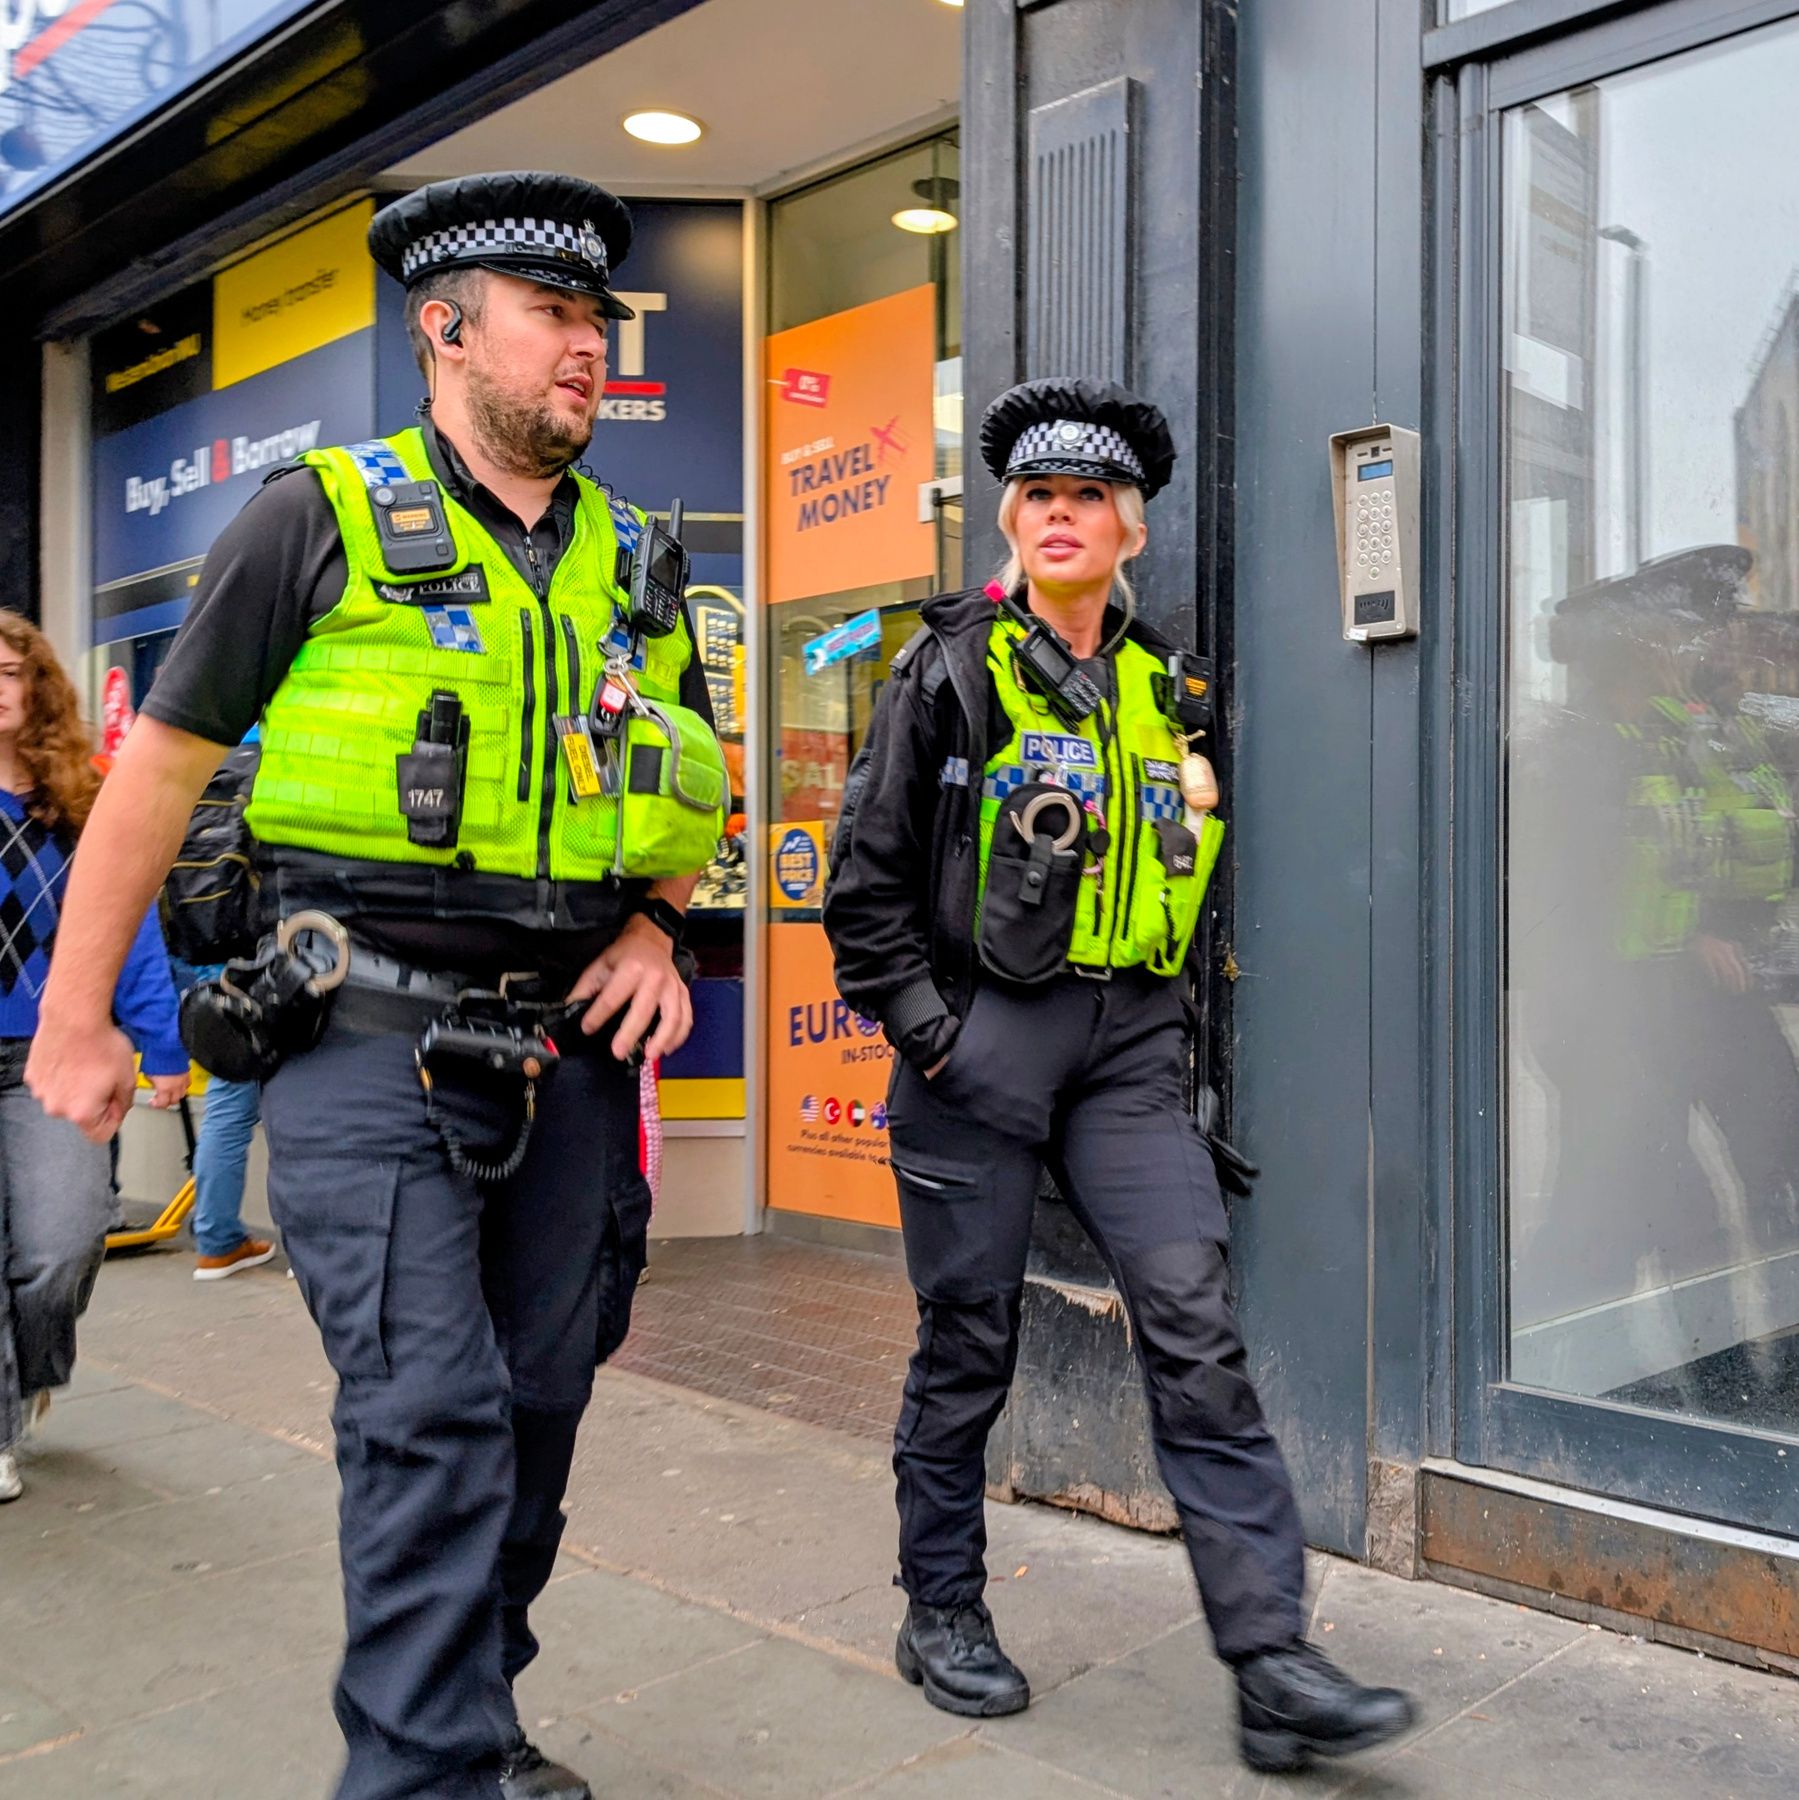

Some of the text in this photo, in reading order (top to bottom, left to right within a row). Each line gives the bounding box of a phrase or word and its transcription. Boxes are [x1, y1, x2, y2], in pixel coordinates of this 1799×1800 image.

[611, 291, 667, 376] T
[597, 398, 667, 422] KERS
[126, 420, 322, 516] Buy, Sell & Borrow
[789, 443, 875, 497] TRAVEL
[797, 474, 892, 532] MONEY
[419, 578, 481, 594] POLICE
[1027, 737, 1094, 761] POLICE
[566, 735, 588, 794] FUEL ONLY
[578, 744, 594, 783] DIESEL
[781, 759, 845, 790] SAL
[408, 788, 444, 808] 1747
[780, 852, 814, 869] BEST
[780, 868, 815, 883] PRICE
[841, 1043, 895, 1065] IN-STOC
[800, 1129, 818, 1141] Plus
[831, 1132, 853, 1144] other
[855, 1135, 888, 1147] popular
